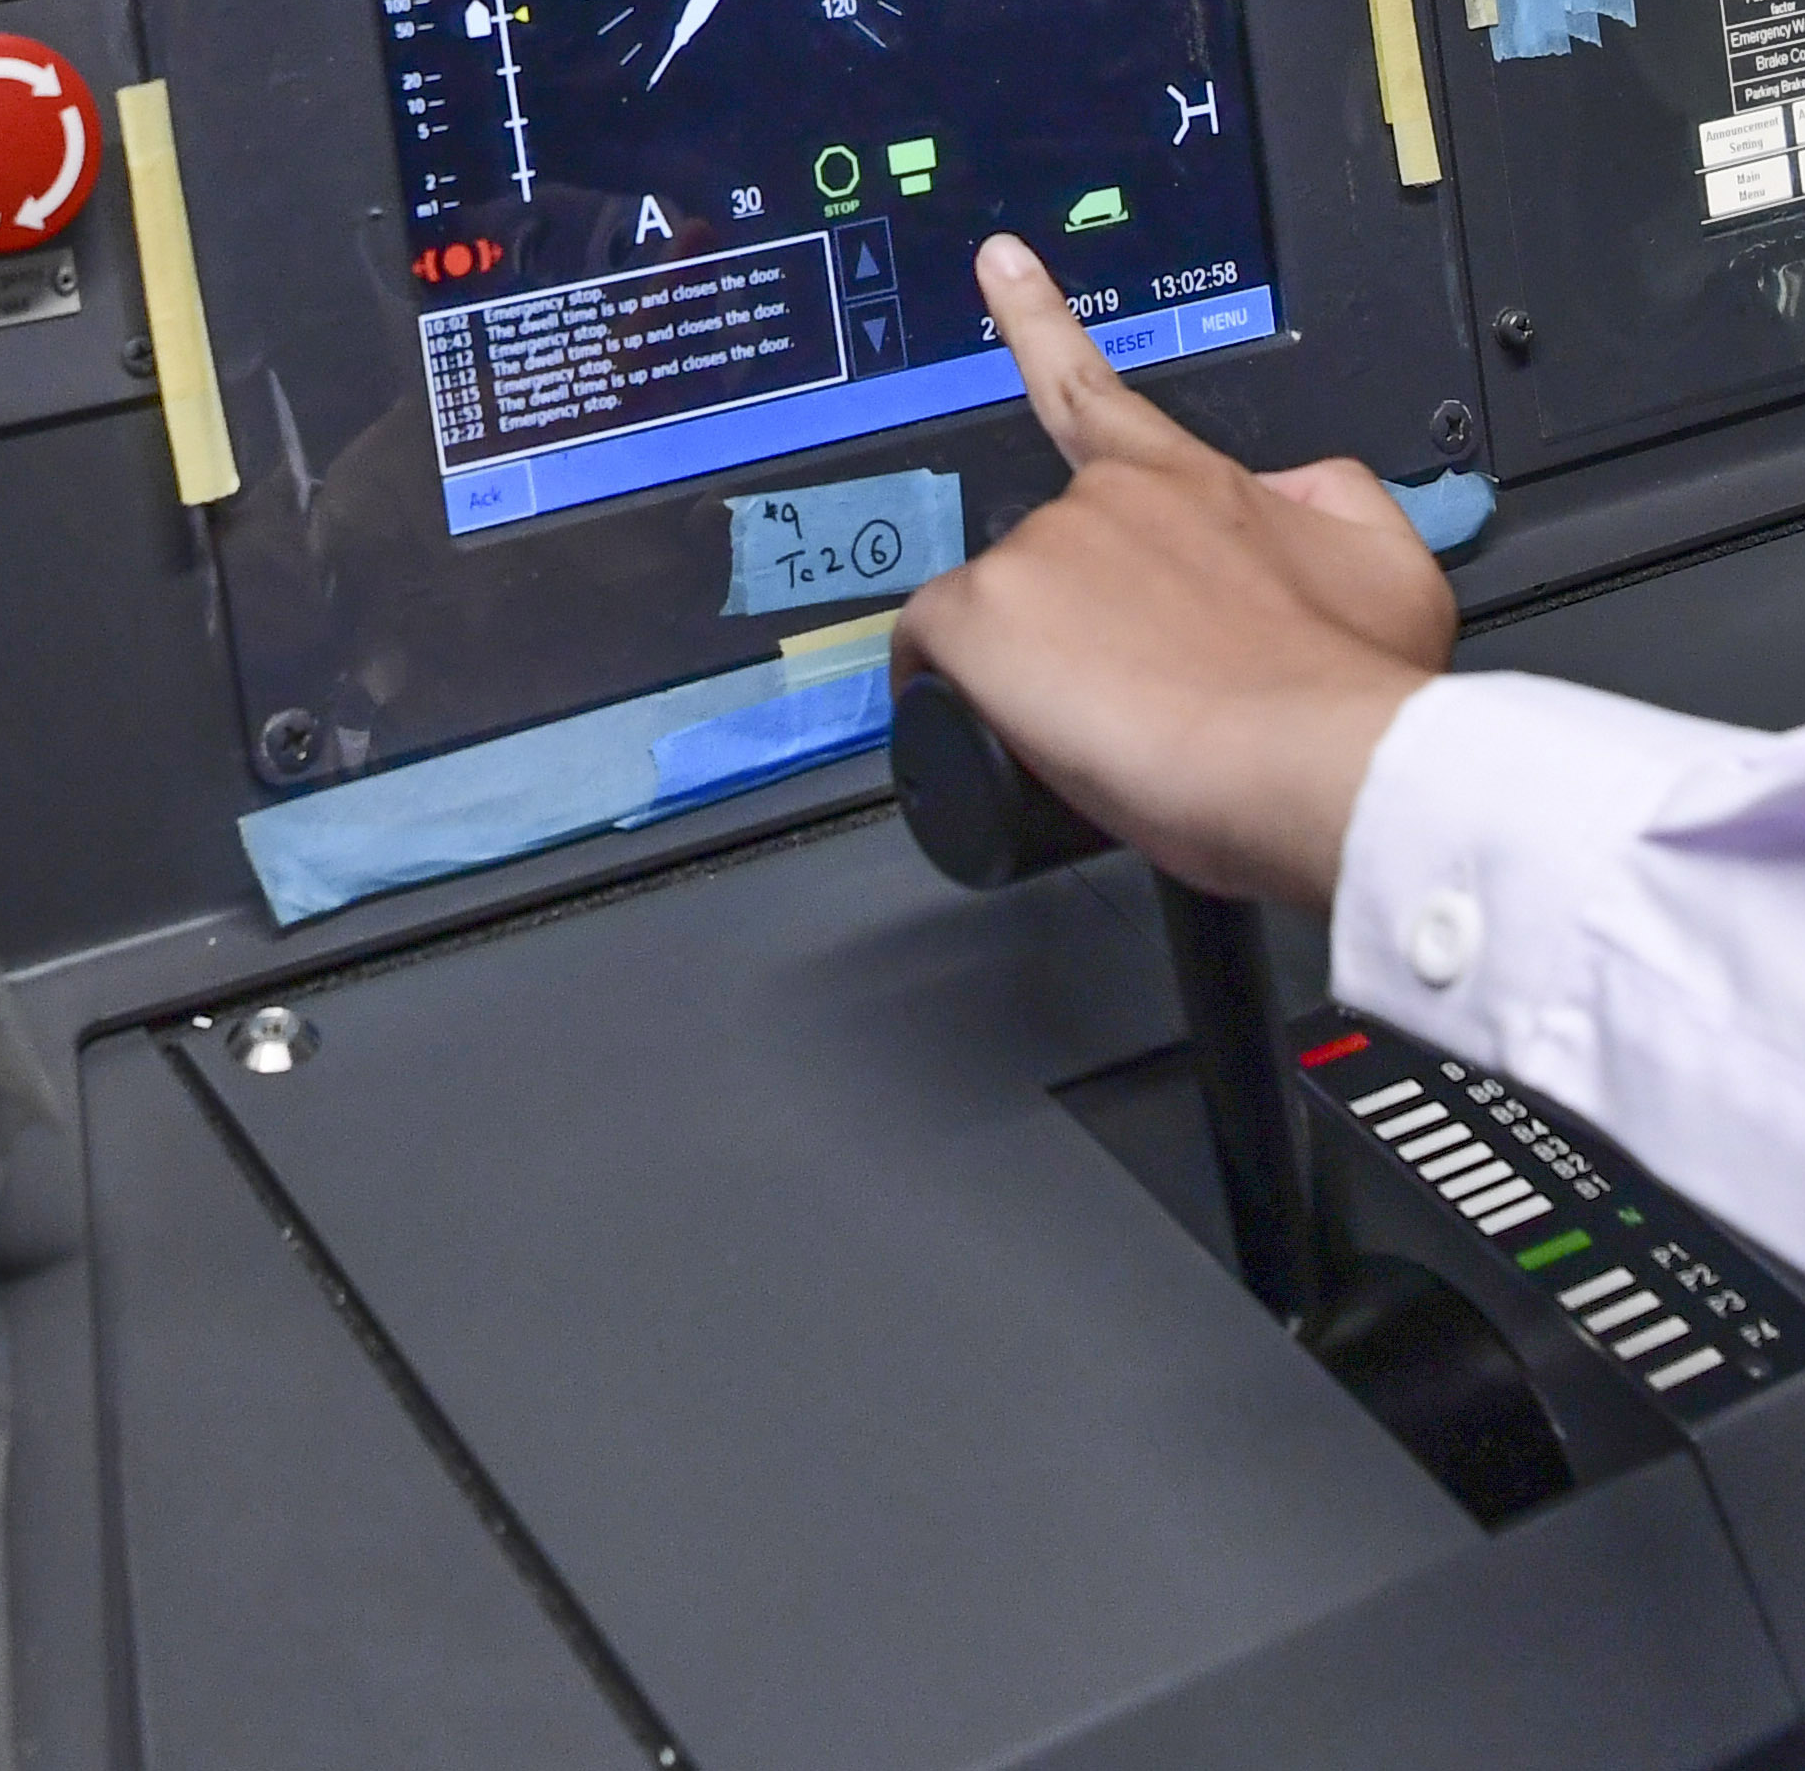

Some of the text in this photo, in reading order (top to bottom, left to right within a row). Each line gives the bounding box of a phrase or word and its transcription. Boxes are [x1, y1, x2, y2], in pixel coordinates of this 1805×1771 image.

[1730, 20, 1791, 48] Emergency
[1755, 49, 1788, 71] Brake
[1744, 81, 1779, 102] Parking
[730, 185, 763, 214] 30
[824, 198, 860, 218] STOP
[629, 190, 673, 244] A
[1150, 259, 1238, 301] 13:02:58
[483, 294, 565, 325] Emergency
[487, 322, 516, 343] The
[618, 299, 639, 316] up
[640, 289, 670, 309] and
[720, 273, 746, 292] the
[748, 264, 786, 286] door.
[1202, 306, 1248, 334] MENU
[1104, 329, 1155, 356] RESET
